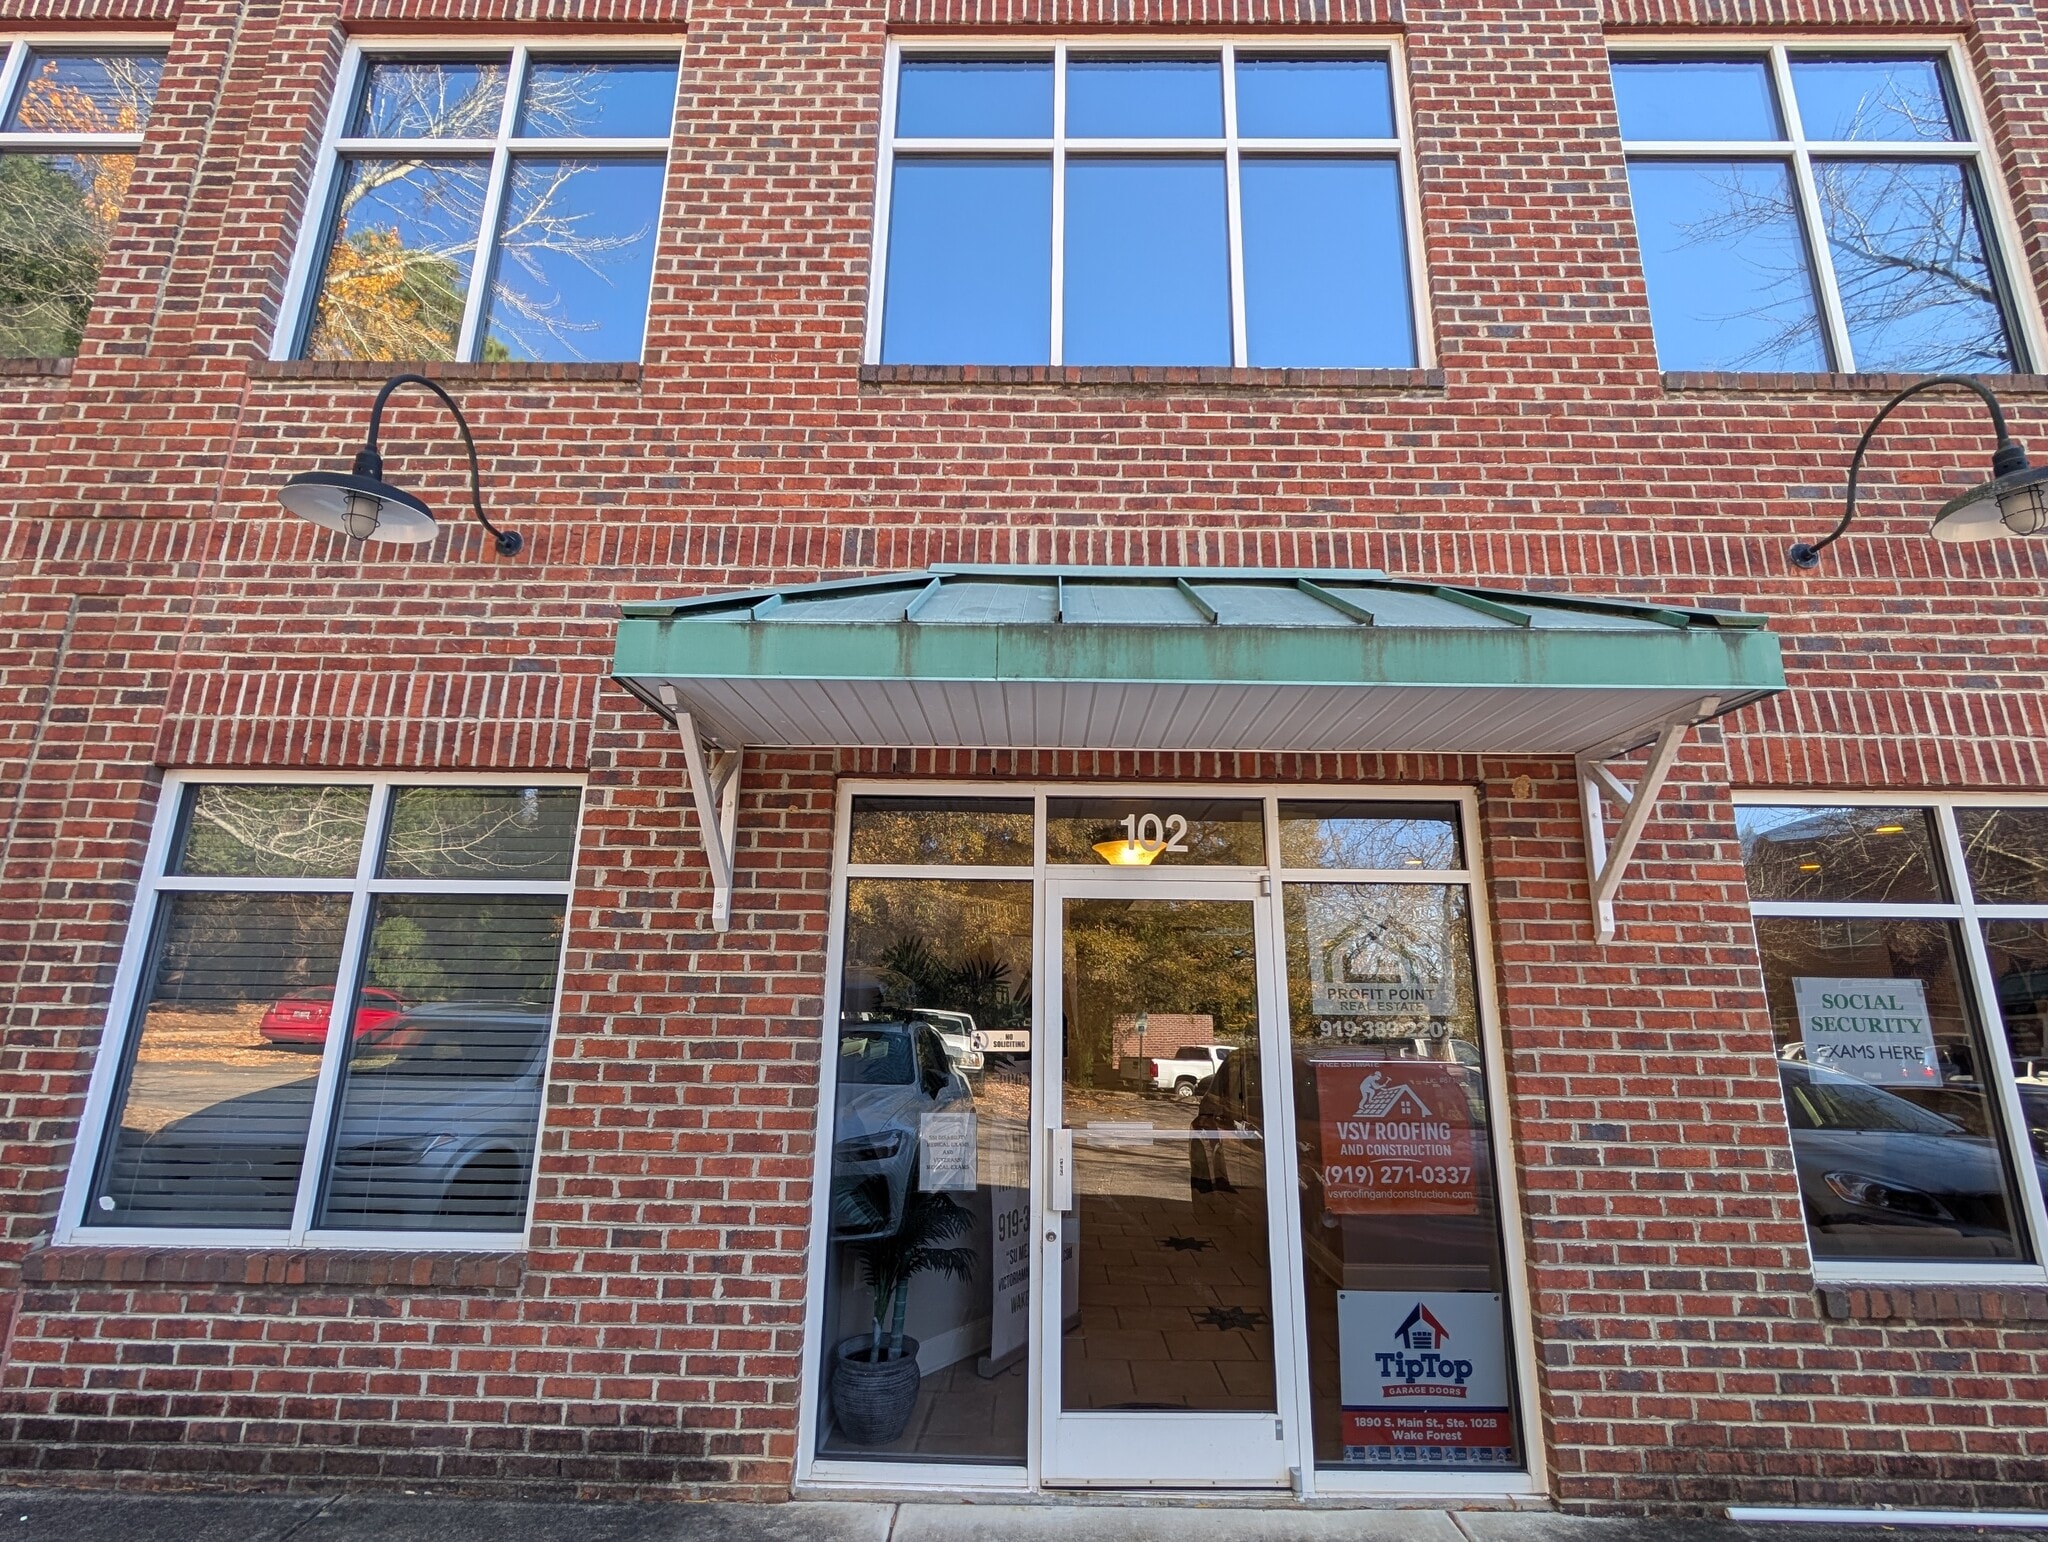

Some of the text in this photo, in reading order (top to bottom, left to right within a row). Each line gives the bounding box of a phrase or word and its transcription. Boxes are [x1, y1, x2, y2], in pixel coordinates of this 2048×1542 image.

[1120, 813, 1188, 852] 102
[1327, 988, 1435, 1000] PROFIT POINT
[1340, 1001, 1424, 1011] REAL ESTATE
[1822, 994, 1904, 1011] SOCIAL
[1811, 1016, 1922, 1034] SECURITY
[993, 1040, 1025, 1048] SOLICITING
[1818, 1044, 1925, 1060] EXAMS HERE
[1336, 1122, 1450, 1140] VSV ROOFING
[1340, 1144, 1452, 1156] AND CONSTRUCTION
[1325, 1166, 1471, 1186] (919) 271-0337
[1328, 1189, 1473, 1200] vsvroofingandconstruction.com
[1375, 1351, 1473, 1384] TipTop
[1389, 1386, 1461, 1396] GARAGE DOORS
[1355, 1417, 1497, 1429] 1890 S. Main St., Ste. 102B
[1392, 1430, 1462, 1440] Wake Forest
